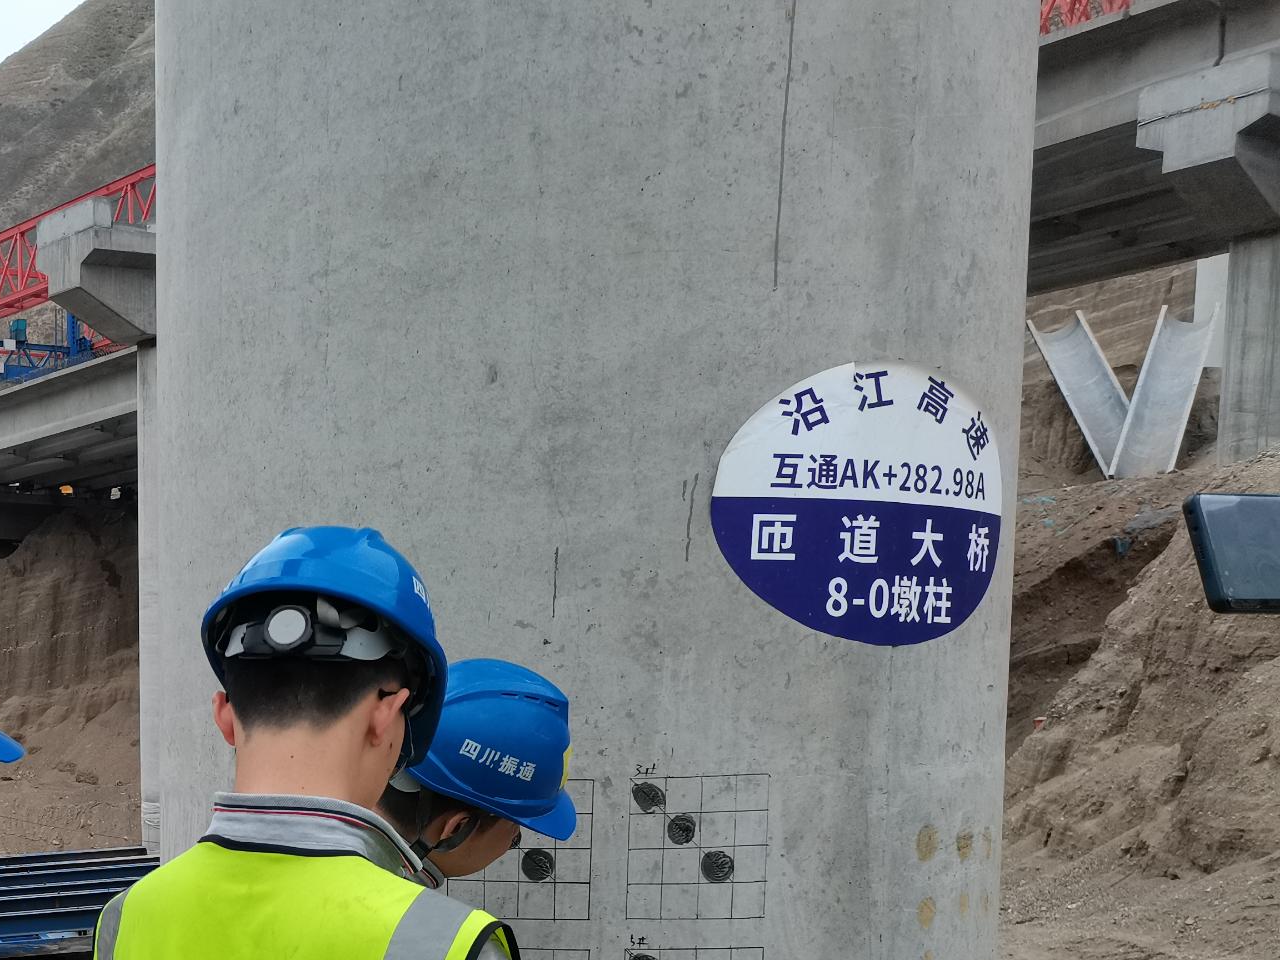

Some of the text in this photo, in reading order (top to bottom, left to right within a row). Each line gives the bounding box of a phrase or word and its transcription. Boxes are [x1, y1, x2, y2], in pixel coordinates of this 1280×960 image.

[778, 370, 989, 460] 沿江高速
[770, 453, 985, 500] 互通AK+282.98A
[750, 513, 990, 572] 匝道大桥
[825, 575, 952, 623] 8-0墩柱
[459, 738, 537, 782] 四川振通
